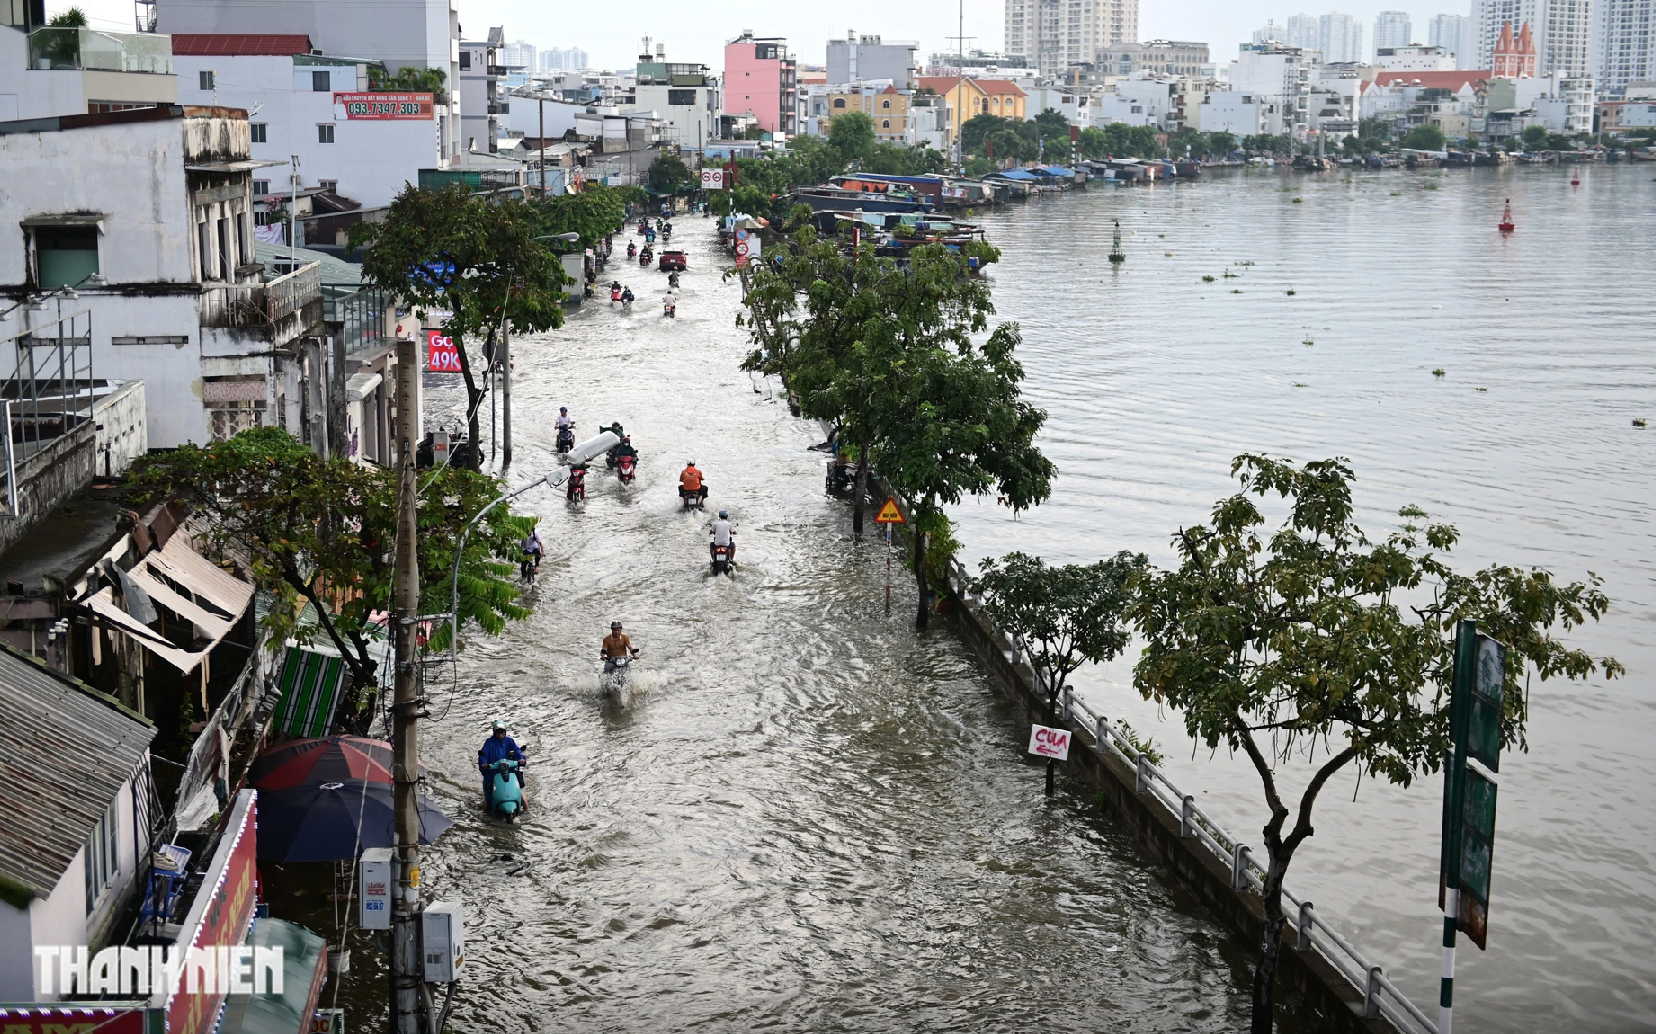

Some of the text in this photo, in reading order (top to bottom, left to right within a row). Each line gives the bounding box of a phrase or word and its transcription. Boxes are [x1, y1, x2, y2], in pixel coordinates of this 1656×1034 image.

[348, 102, 419, 114] 093.7347.303
[431, 351, 461, 370] 49K
[1035, 729, 1067, 750] CUA
